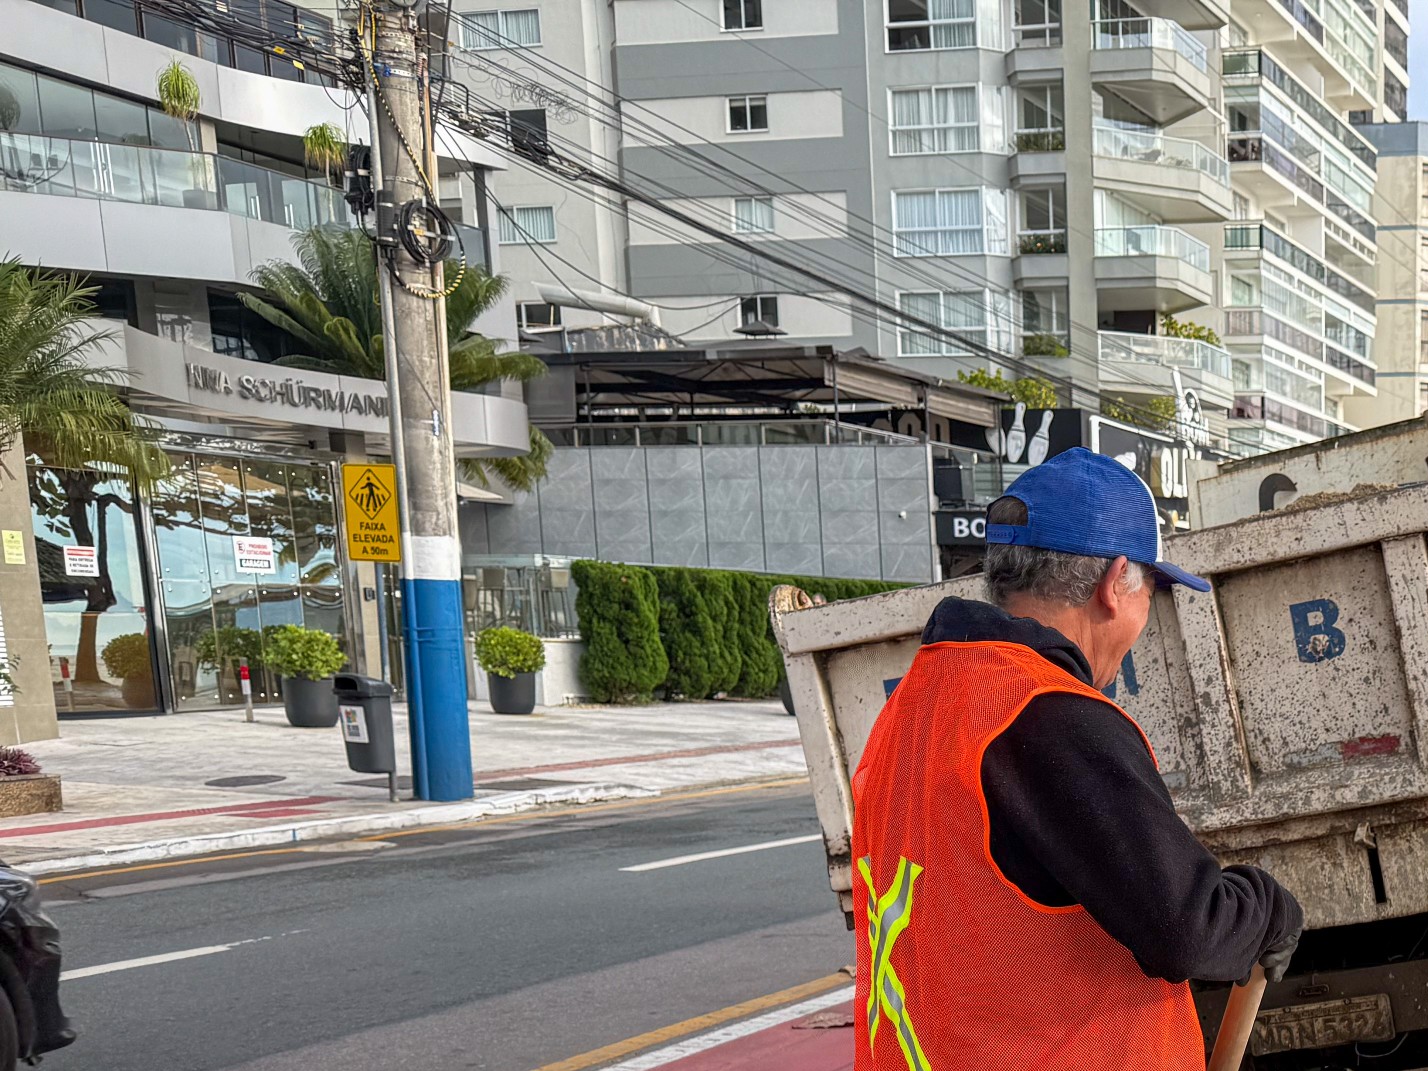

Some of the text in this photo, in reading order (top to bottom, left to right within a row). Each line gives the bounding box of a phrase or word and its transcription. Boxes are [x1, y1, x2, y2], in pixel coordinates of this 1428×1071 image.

[360, 522, 386, 531] FAIXA
[352, 533, 395, 544] ELEVADA
[362, 546, 389, 556] A 50m
[1289, 598, 1347, 664] B
